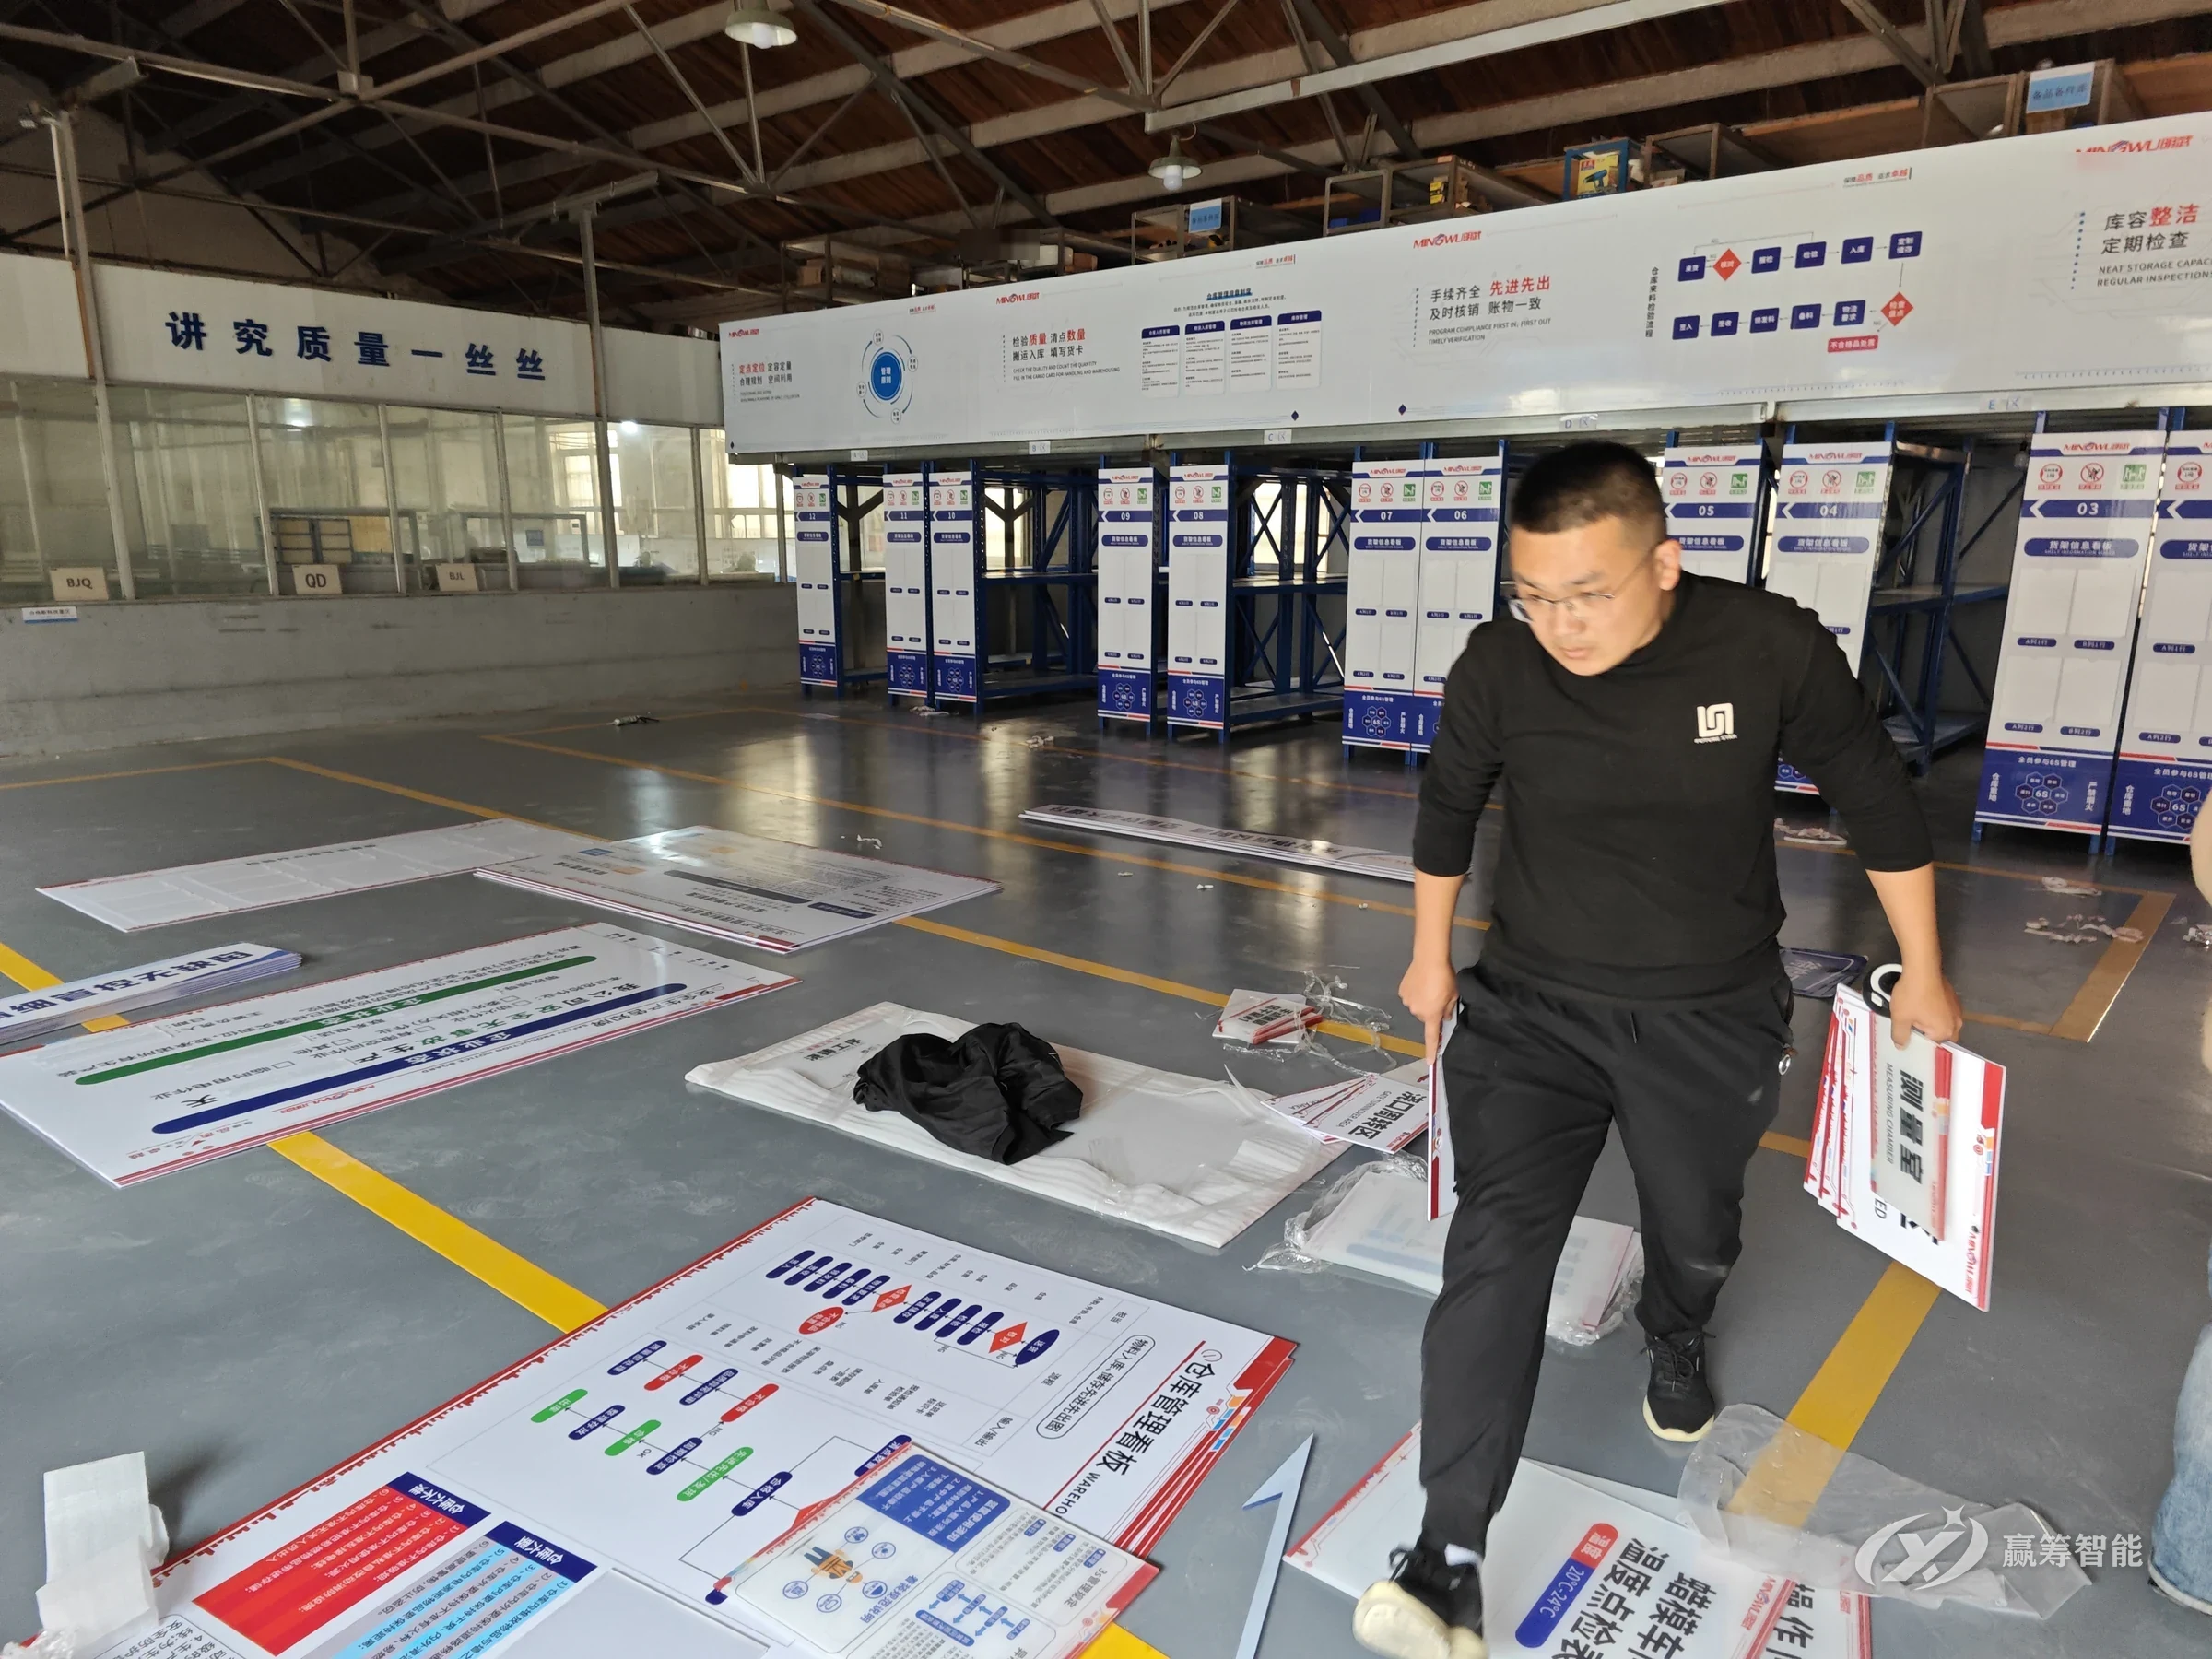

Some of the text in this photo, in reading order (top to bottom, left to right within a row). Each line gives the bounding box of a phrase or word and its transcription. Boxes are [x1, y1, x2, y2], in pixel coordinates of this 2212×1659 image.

[2104, 204, 2199, 231] 库容整洁
[2101, 231, 2189, 254] 定期检查
[2099, 257, 2212, 274] NEAT STORAGE CAPAC
[1430, 276, 1550, 303] 手续齐全 先进先出
[2097, 276, 2143, 288] REGULAR
[1430, 296, 1541, 321] 及时核销 账物一致
[1013, 328, 1085, 347] 检验质量 清点数量
[1429, 327, 1455, 335] PROGRAM
[1456, 324, 1491, 333] COMPLIANCE
[166, 312, 546, 380] 讲究质量一丝丝
[1447, 335, 1485, 344] VERIFICATION
[1013, 345, 1083, 361] 搬运入库 填写货卡
[947, 512, 956, 520] 10
[1121, 512, 1130, 521] 09
[1381, 512, 1393, 521] 07
[1454, 511, 1467, 520] 06
[1698, 505, 1714, 516] 05
[1819, 505, 1838, 516] 04
[2077, 502, 2099, 515] 03
[1679, 537, 1724, 546] 货架信息看板
[1797, 538, 1849, 547] 货架信息看板
[2049, 540, 2112, 550] 货架信息看板
[66, 578, 92, 589] BJQ
[305, 573, 326, 589] QD
[449, 571, 465, 581] BJL
[2018, 756, 2077, 768] 全员参与6S管理
[2035, 789, 2049, 798] 6S
[2172, 803, 2186, 811] 6S
[314, 997, 427, 1025] 企业状态
[175, 983, 645, 1108] 我公司安全无事故生产 天
[289, 1043, 335, 1054] 其他
[401, 1031, 514, 1064] 企业状态
[147, 1066, 273, 1100] 临时用电作业
[1348, 1091, 1427, 1139] 浇口周转区
[1886, 1063, 1894, 1164] MEASURING CHAMBER
[1900, 1069, 1924, 1184] 测量室
[806, 1312, 839, 1331] 不合格品
[927, 1308, 947, 1319] 入库
[947, 1314, 968, 1326] 检验
[970, 1322, 989, 1334] 报检
[997, 1331, 1018, 1343] 核对
[1025, 1339, 1046, 1353] 送货
[657, 1363, 689, 1381] 不合格
[1040, 1371, 1061, 1385] 流程
[861, 1378, 886, 1394] 入库单
[1043, 1337, 1148, 1432] 物料入库、储存先进先出图
[545, 1398, 572, 1412] 出库
[733, 1393, 766, 1412] 不合格
[923, 1401, 947, 1418] 送货单
[571, 1407, 619, 1435] 整理存放
[1093, 1359, 1219, 1476] 仓库管理看板
[619, 1430, 648, 1444] 合格
[706, 1427, 723, 1436] NG
[973, 1416, 1014, 1447] 输入/输出
[635, 1448, 653, 1457] OK
[651, 1441, 698, 1470] 周期检查
[680, 1449, 748, 1497] 先进先出/发货
[406, 1483, 468, 1514] 仓库六不准
[738, 1477, 783, 1509] 合格入库
[512, 1535, 567, 1566] 仓库六要
[1580, 1531, 1611, 1561] 温度
[858, 1574, 919, 1622] 着装规范说明
[1552, 1536, 1665, 1659] 温度点检表
[1626, 1572, 1718, 1659] 蜡模车
[1766, 1583, 1815, 1659] 操作
